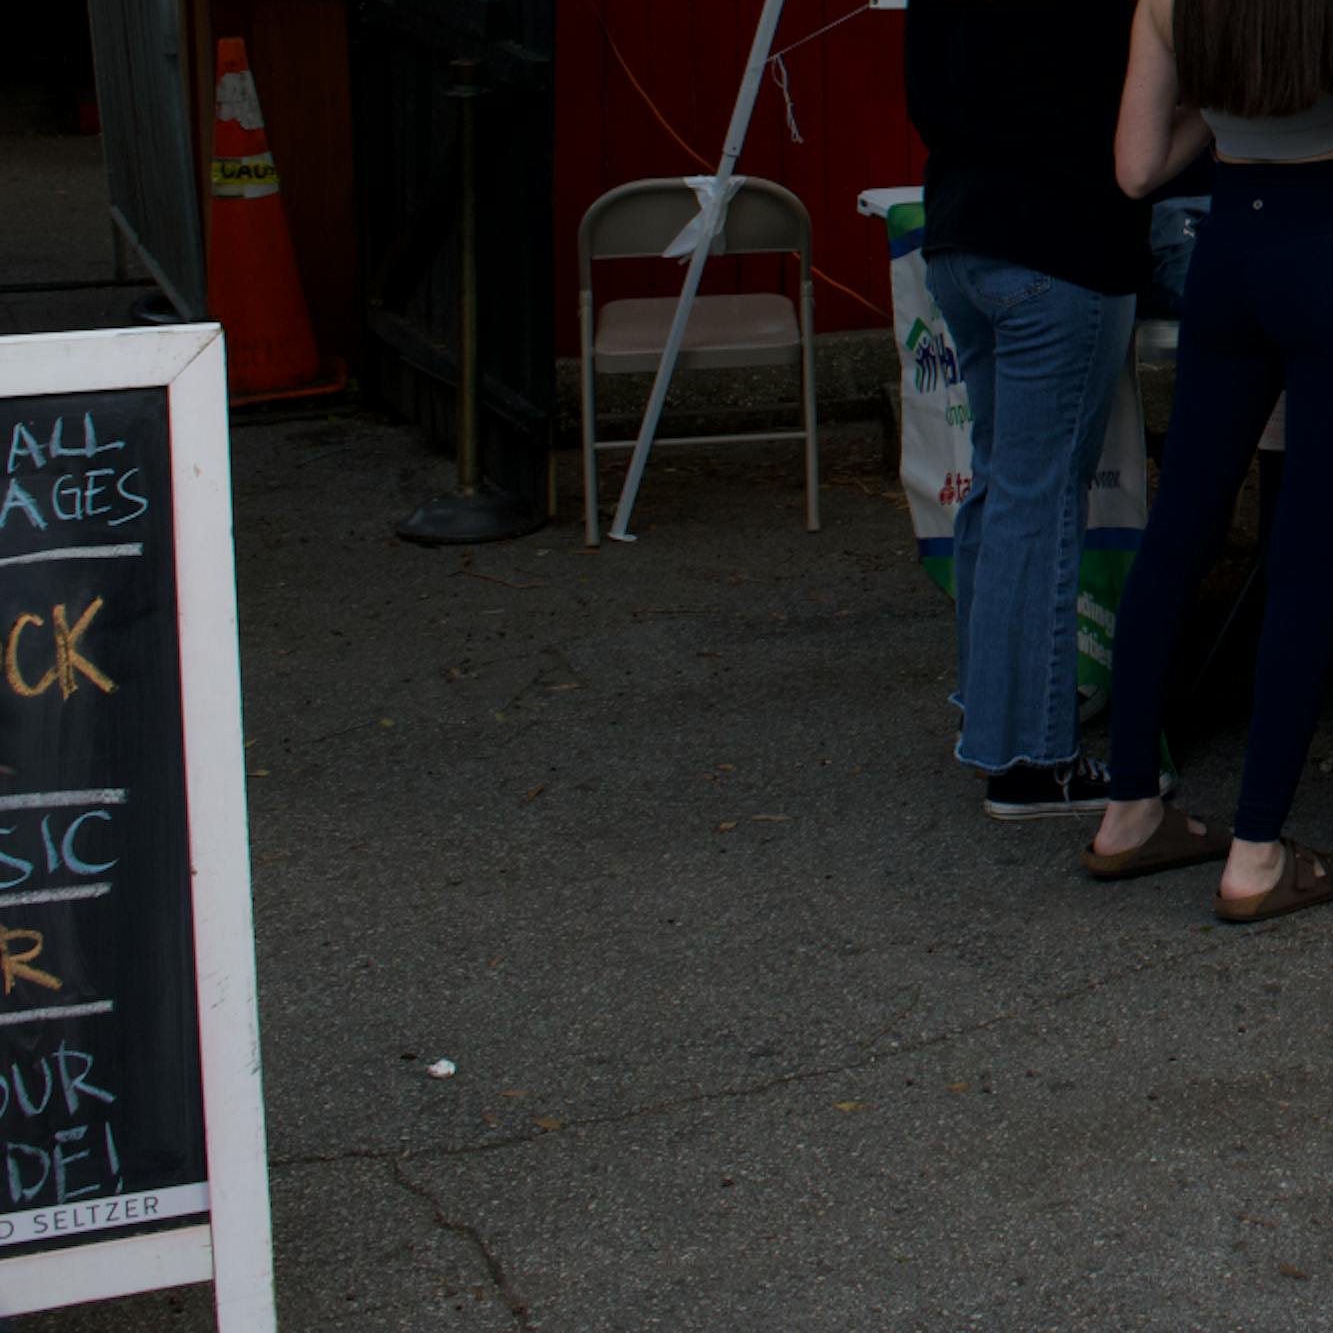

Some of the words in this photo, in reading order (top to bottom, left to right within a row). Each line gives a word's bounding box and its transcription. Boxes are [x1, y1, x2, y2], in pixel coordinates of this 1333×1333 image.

[7, 410, 127, 475] ALL
[0, 467, 150, 531] AGES
[3, 594, 119, 701] CK
[33, 1195, 160, 1234] SELTZER
